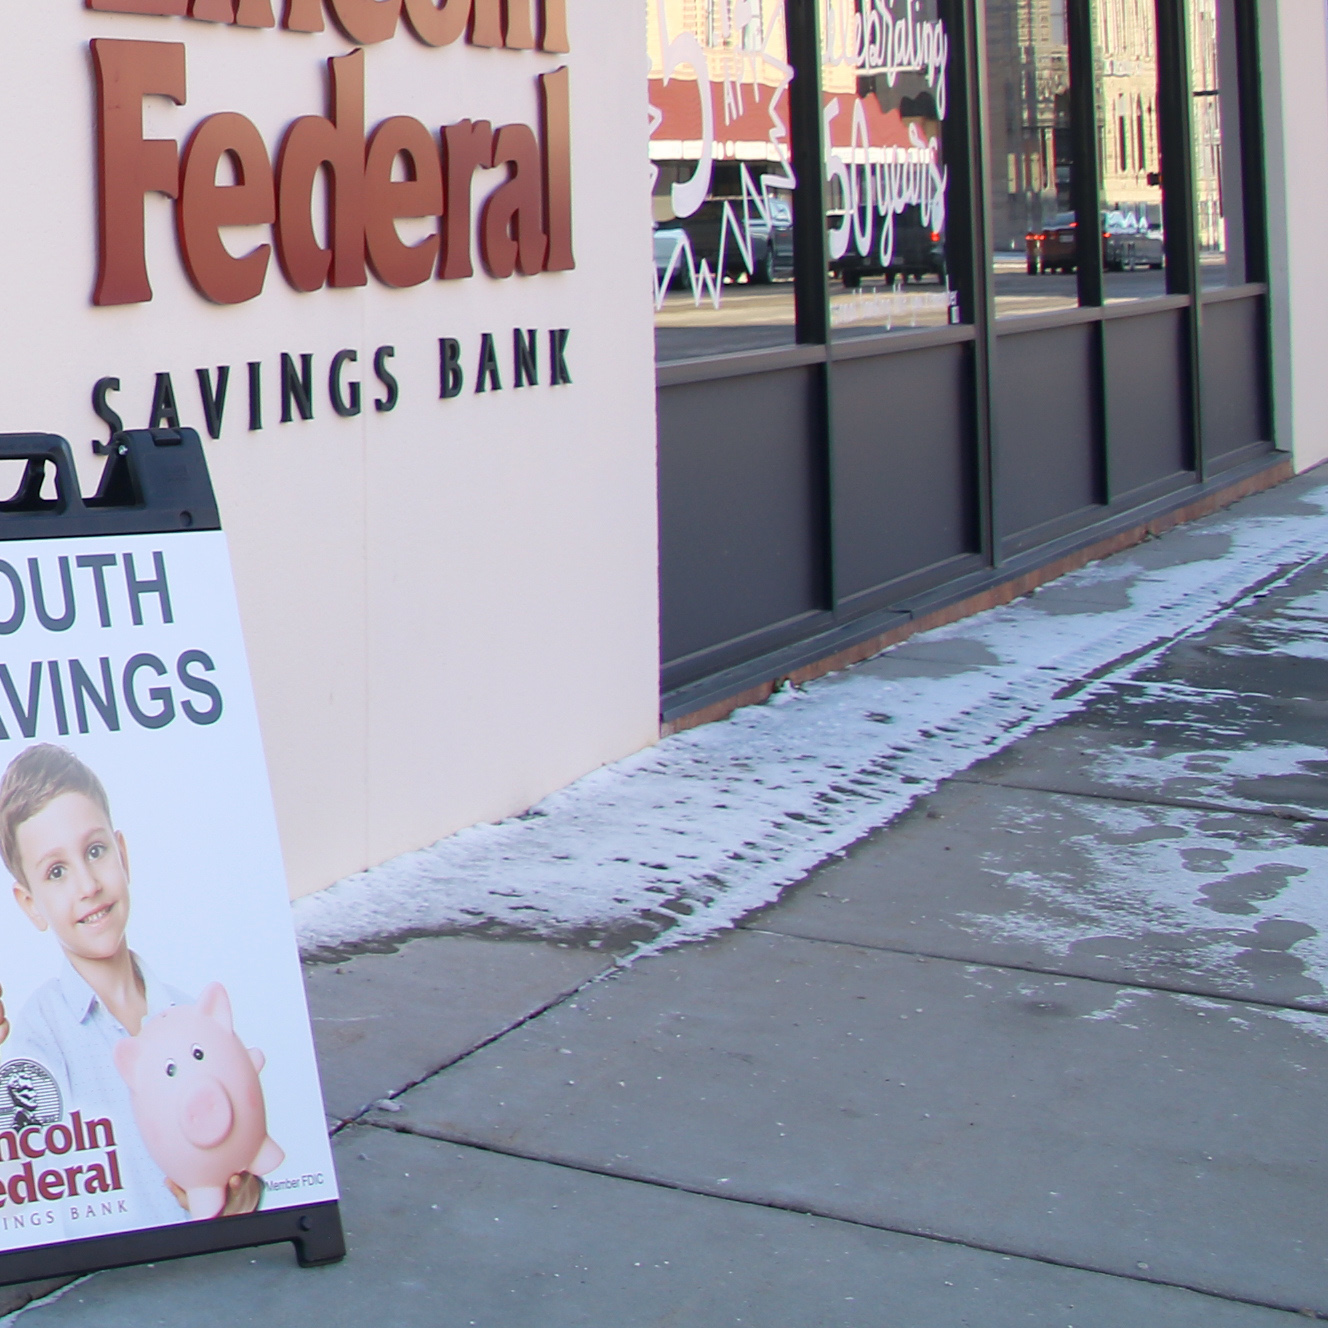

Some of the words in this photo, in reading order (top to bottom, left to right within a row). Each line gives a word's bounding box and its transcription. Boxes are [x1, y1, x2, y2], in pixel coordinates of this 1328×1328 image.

[90, 38, 575, 307] Federal
[823, 96, 873, 259] 50
[876, 122, 949, 267] years
[90, 343, 398, 455] SAVINGS
[437, 326, 573, 400] BANK
[70, 1199, 130, 1220] BANK
[265, 1178, 300, 1191] Member
[301, 1173, 324, 1185] FDIC
